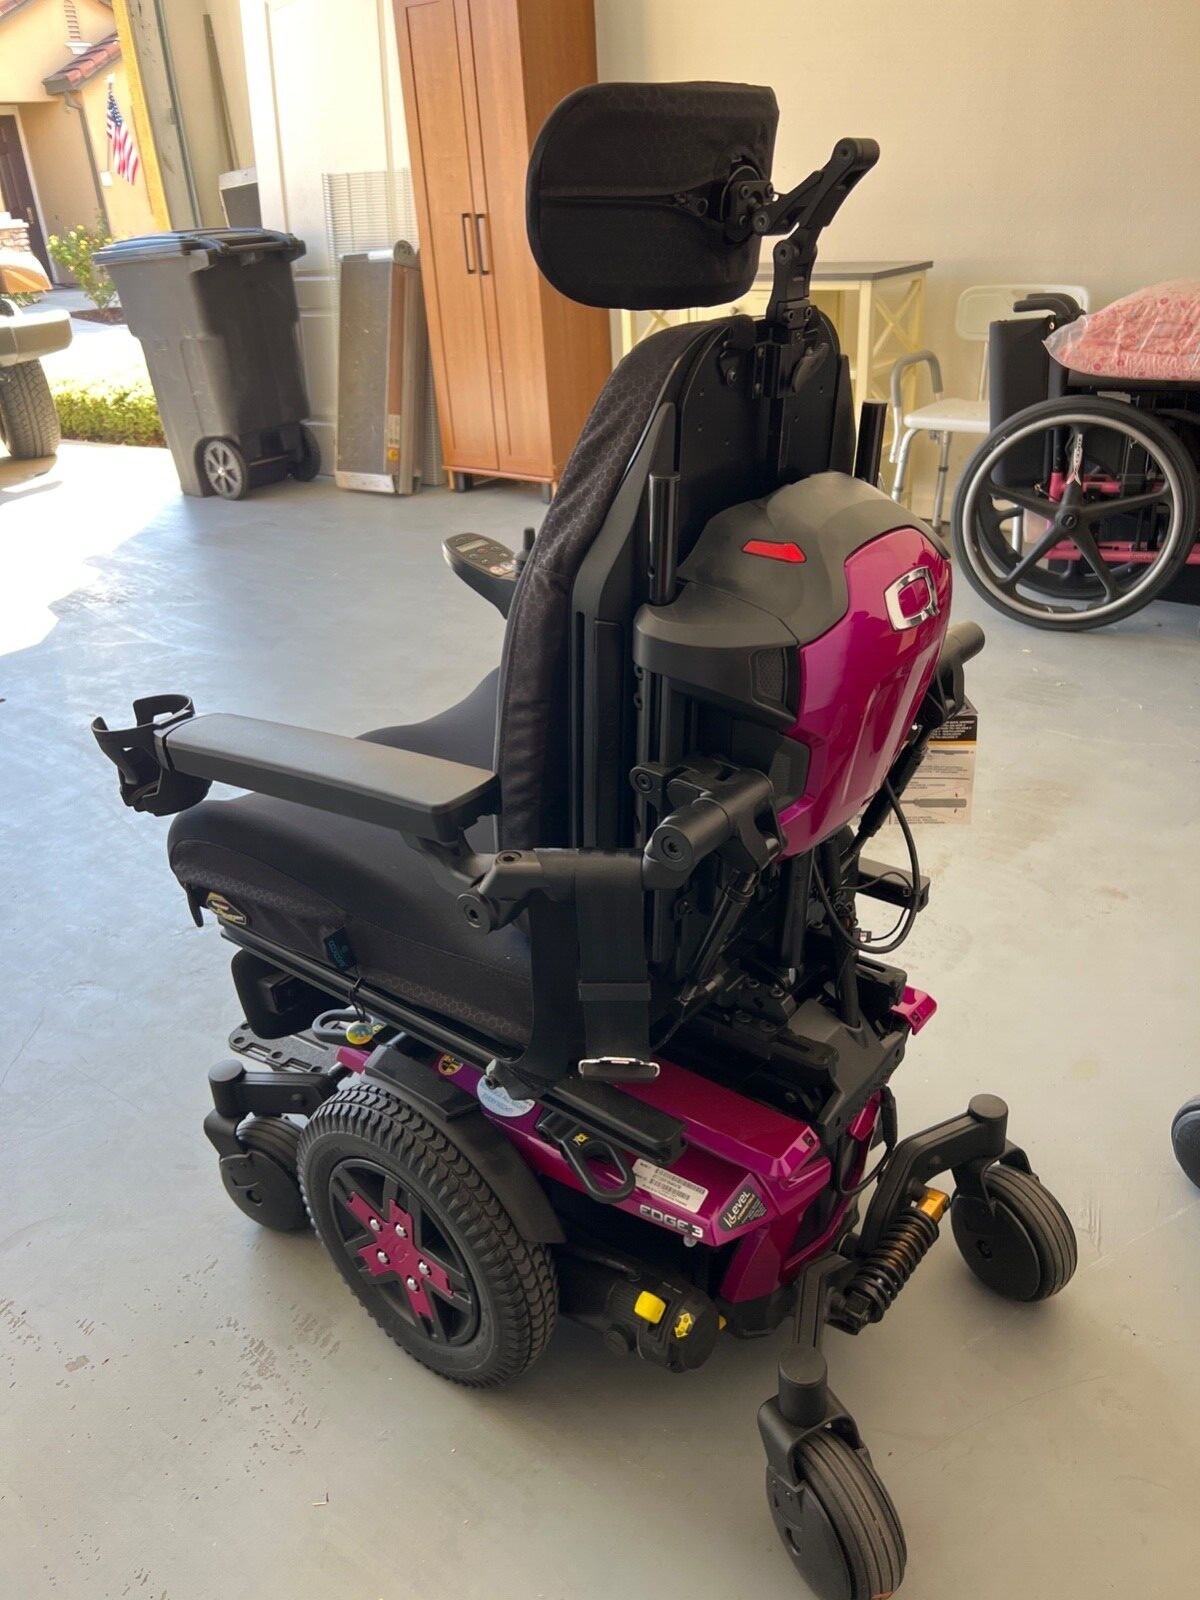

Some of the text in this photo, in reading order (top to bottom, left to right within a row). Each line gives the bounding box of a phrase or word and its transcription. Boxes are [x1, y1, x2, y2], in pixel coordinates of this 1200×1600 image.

[885, 566, 940, 631] Q
[640, 1204, 704, 1239] EDGE 3
